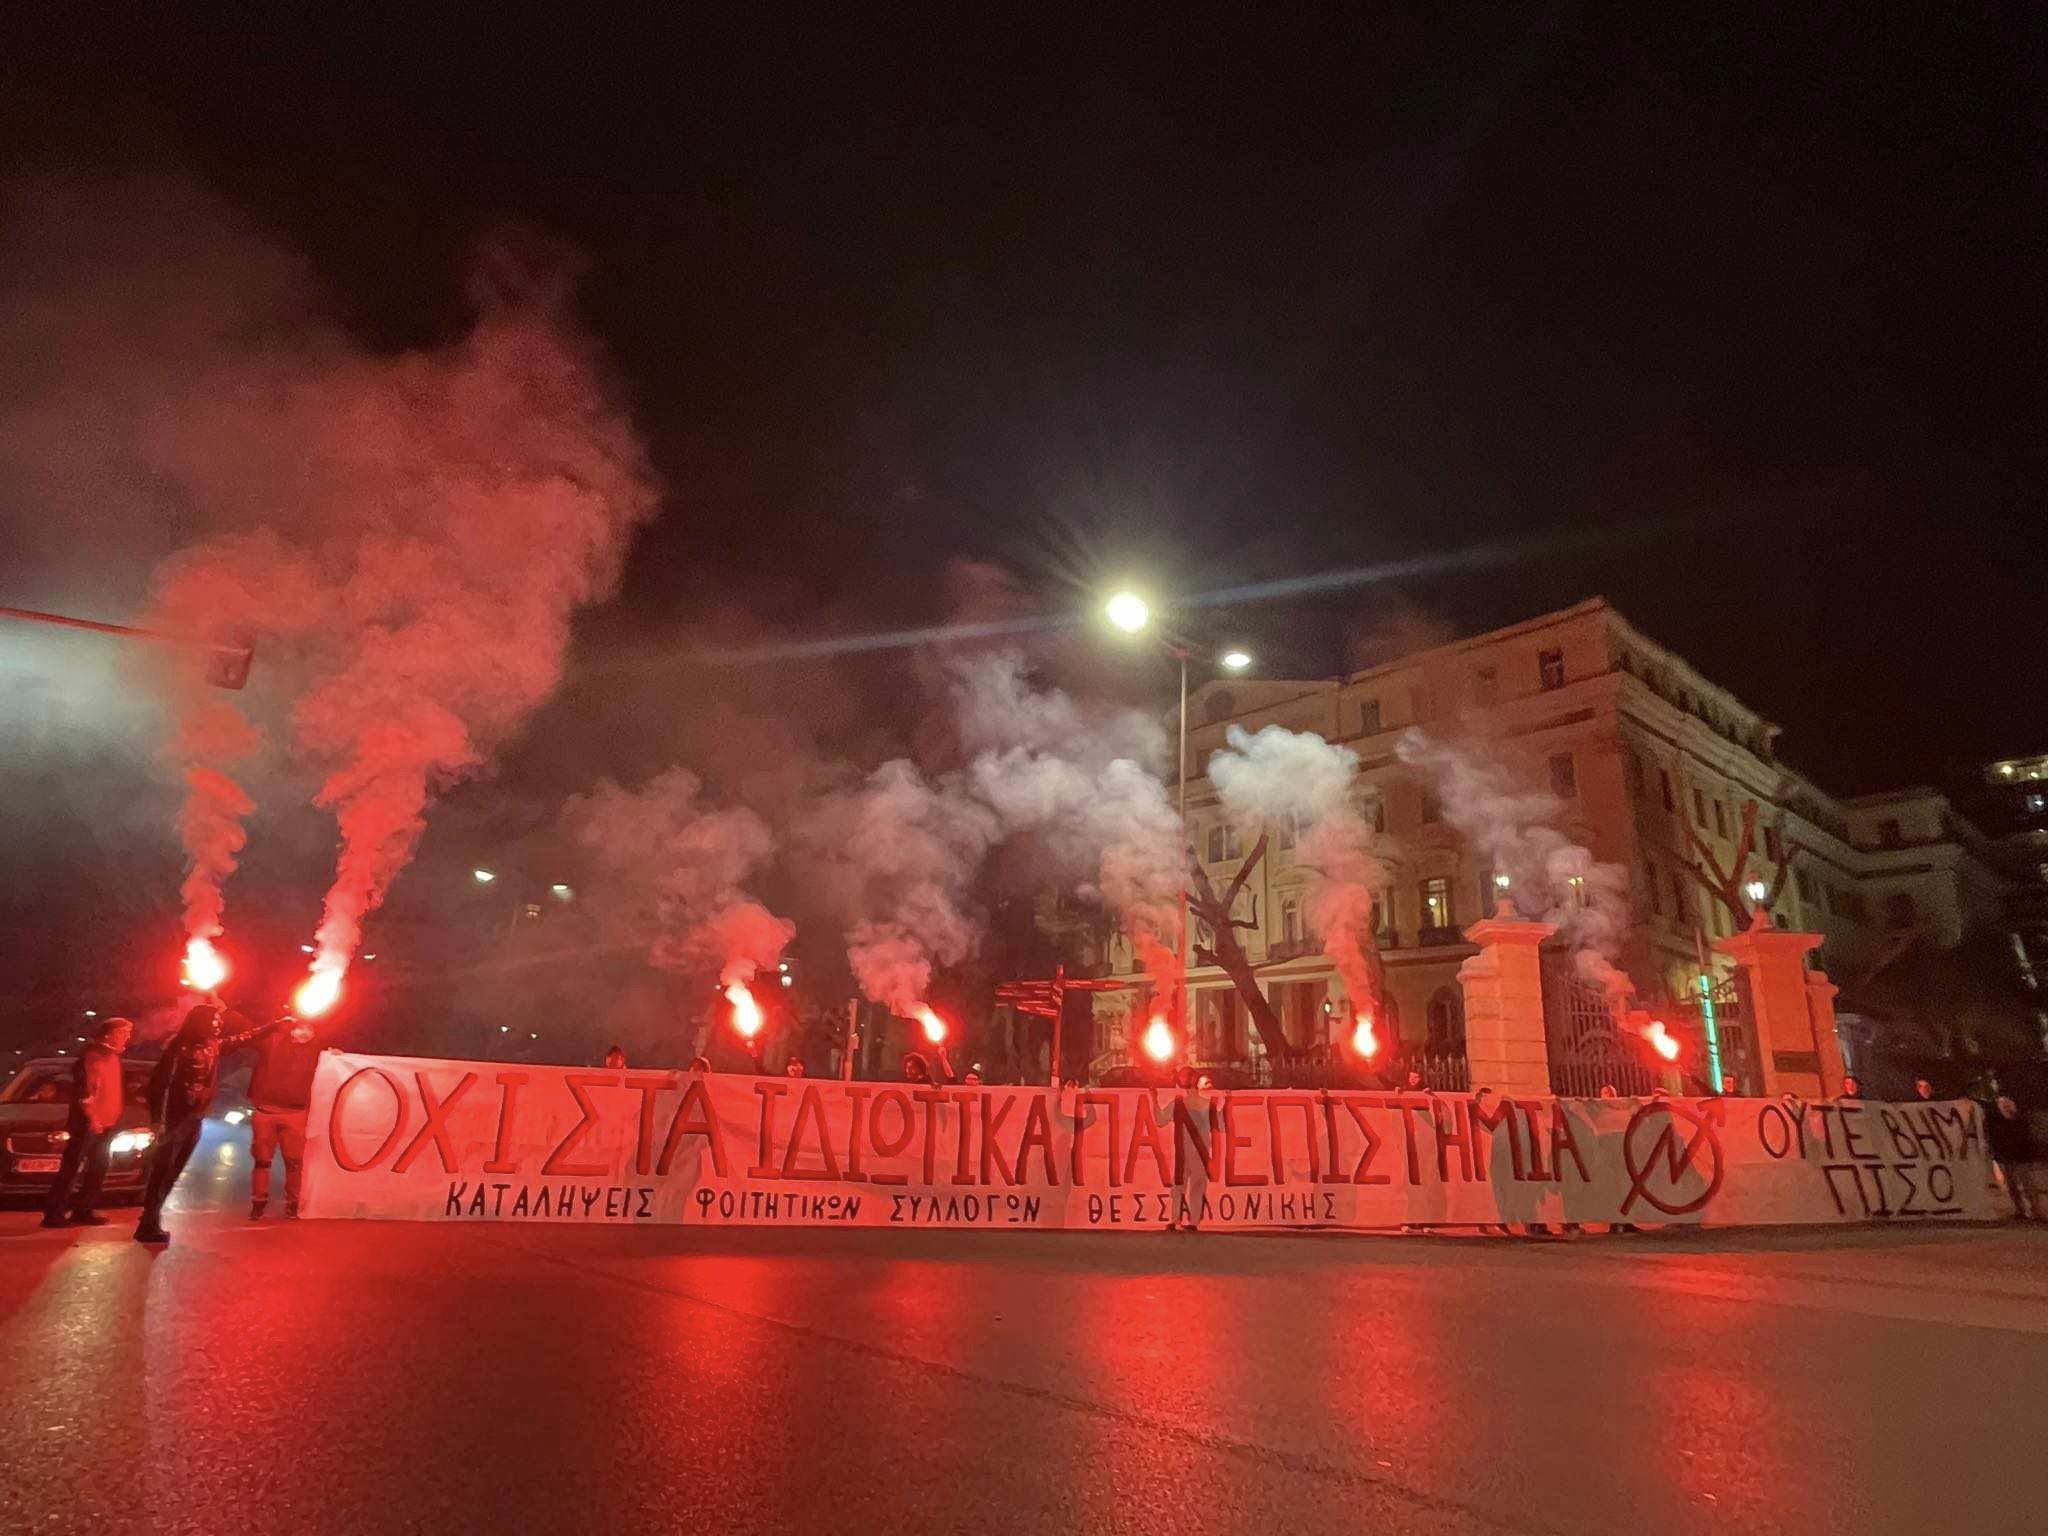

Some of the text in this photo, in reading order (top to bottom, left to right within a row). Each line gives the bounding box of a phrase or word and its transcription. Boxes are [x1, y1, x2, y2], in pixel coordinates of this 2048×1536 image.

[329, 1067, 529, 1174] ΟΧΙ
[541, 1075, 730, 1177] ΣΤΑ
[1070, 1093, 1591, 1187] ΠΑΝΕΠΙΣΤΗΜΙΑ
[1757, 1102, 1880, 1161] ΟΥΤΕ
[445, 1181, 655, 1218] ΚΑΤΑΛΗΨΕΙΣ
[1087, 1192, 1337, 1224] ΘΕΣΣΑΛΟΝΙΚΗΣ
